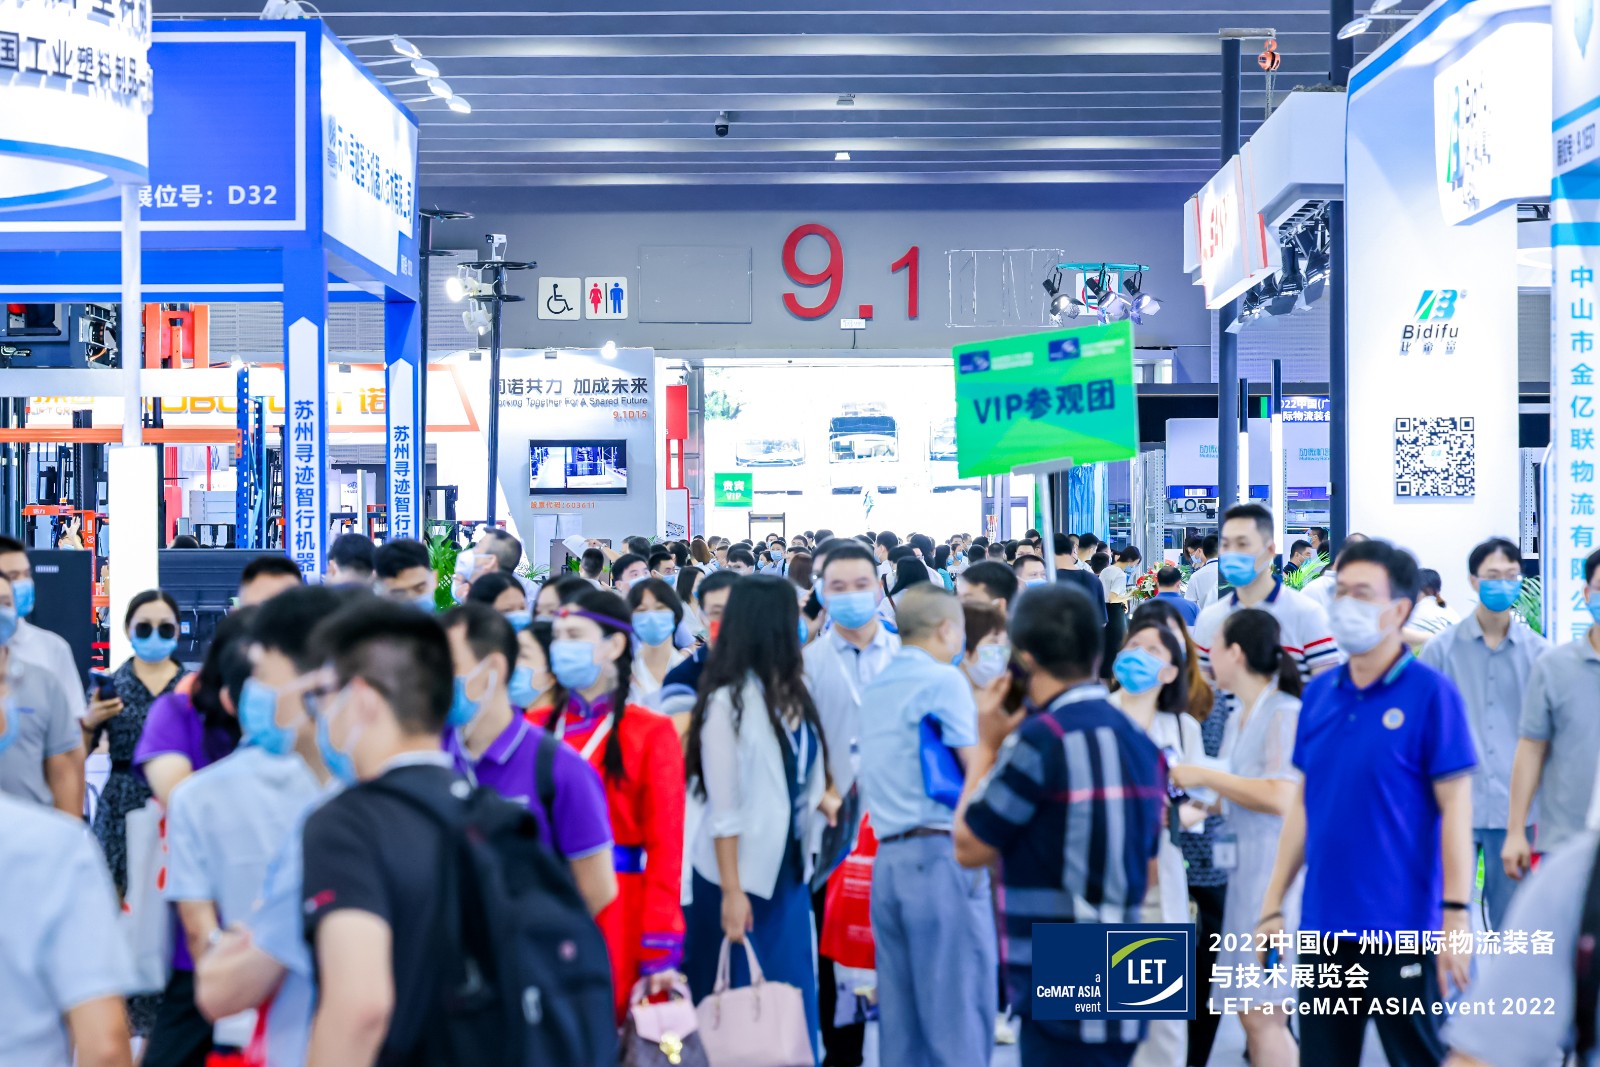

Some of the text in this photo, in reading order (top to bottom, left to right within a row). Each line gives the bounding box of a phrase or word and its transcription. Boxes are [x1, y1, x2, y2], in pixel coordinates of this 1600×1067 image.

[228, 185, 278, 205] D32
[782, 223, 919, 319] 9.1
[1402, 324, 1459, 340] Bidifu
[573, 377, 648, 394] 加成未来
[499, 399, 523, 412] orking
[621, 396, 648, 405] Future
[973, 379, 1115, 424] VIP参观团
[612, 410, 648, 420] 9.1D15
[725, 492, 742, 501] VIP
